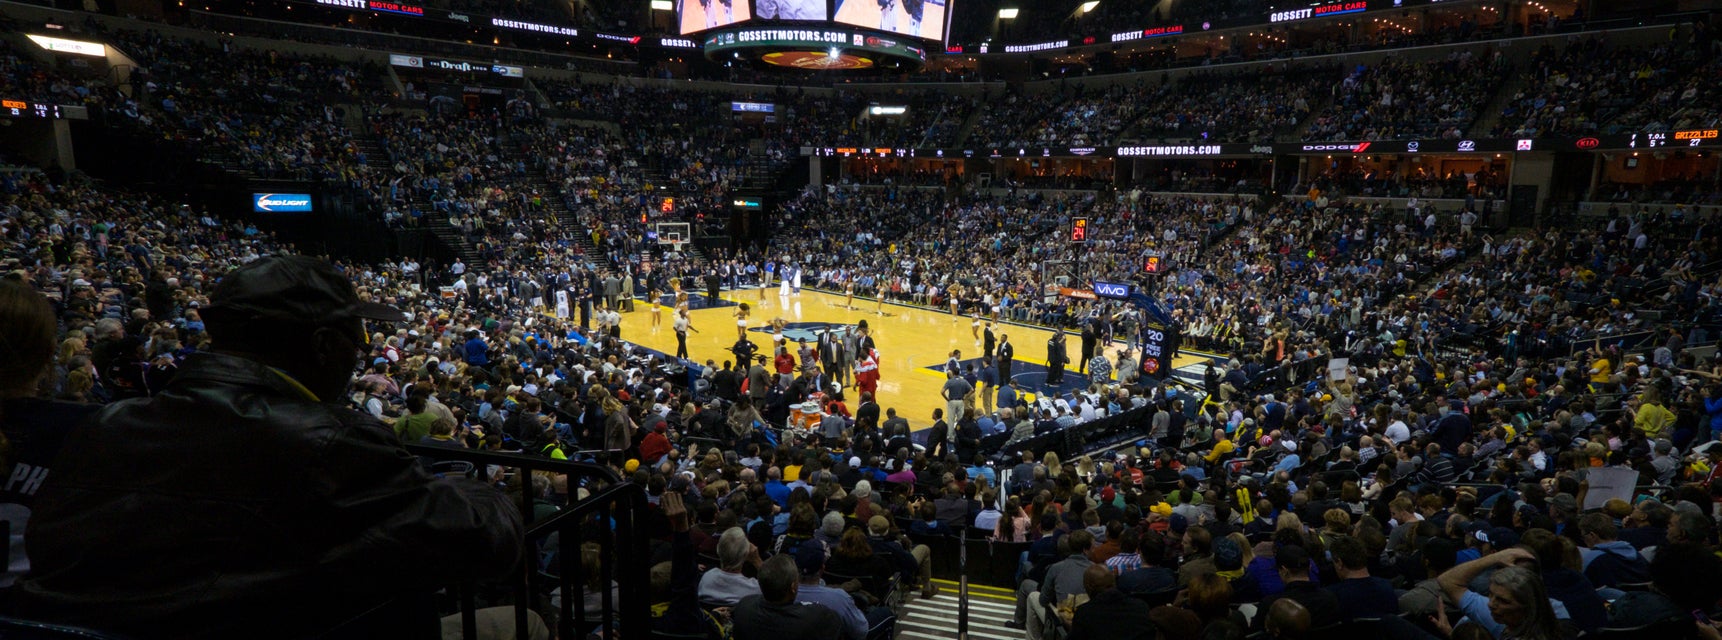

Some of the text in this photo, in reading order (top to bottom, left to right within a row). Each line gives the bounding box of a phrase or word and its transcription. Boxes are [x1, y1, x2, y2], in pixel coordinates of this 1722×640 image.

[369, 1, 399, 10] MOTOR
[401, 6, 423, 14] CARS
[1270, 1, 1367, 22] GOSSETT MOTOR CARS
[448, 12, 469, 23] Jeep
[492, 18, 578, 36] GOSSETTMOTORS.COM
[738, 29, 847, 43] GOSSETTMOTORS.COM
[1111, 30, 1144, 42] GOSSETT
[440, 60, 471, 72] Draft
[1675, 130, 1718, 140] GRIZZLIES
[1689, 138, 1701, 147] 27
[1117, 145, 1221, 156] GOSSETTMOTORS.COM
[1250, 145, 1273, 154] Jeep
[662, 202, 673, 211] 24
[1073, 227, 1085, 240] 24
[1097, 284, 1125, 296] vivo
[1146, 343, 1161, 352] FREE
[1146, 350, 1161, 358] PLAY
